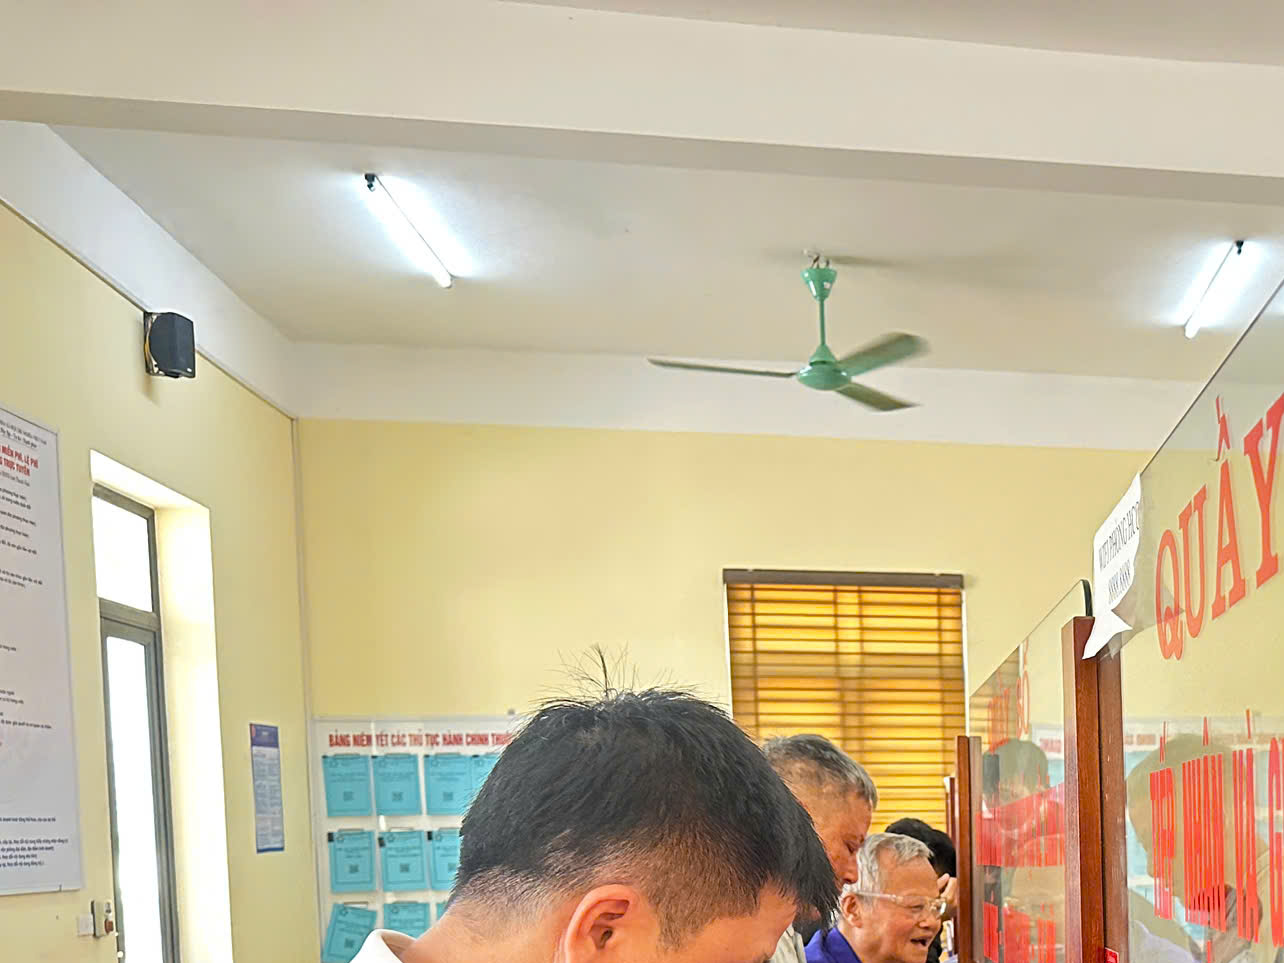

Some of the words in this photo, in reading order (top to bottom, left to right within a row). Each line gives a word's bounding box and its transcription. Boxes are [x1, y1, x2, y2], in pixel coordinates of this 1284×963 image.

[328, 729, 351, 748] BẢNG
[375, 730, 389, 747] YẾT
[391, 731, 406, 747] CÁC
[425, 733, 440, 749] TỤC
[442, 730, 463, 748] HÀNH
[465, 730, 489, 748] CHÍNH
[1150, 721, 1177, 921] TIẾP
[1232, 709, 1261, 945] VÀ
